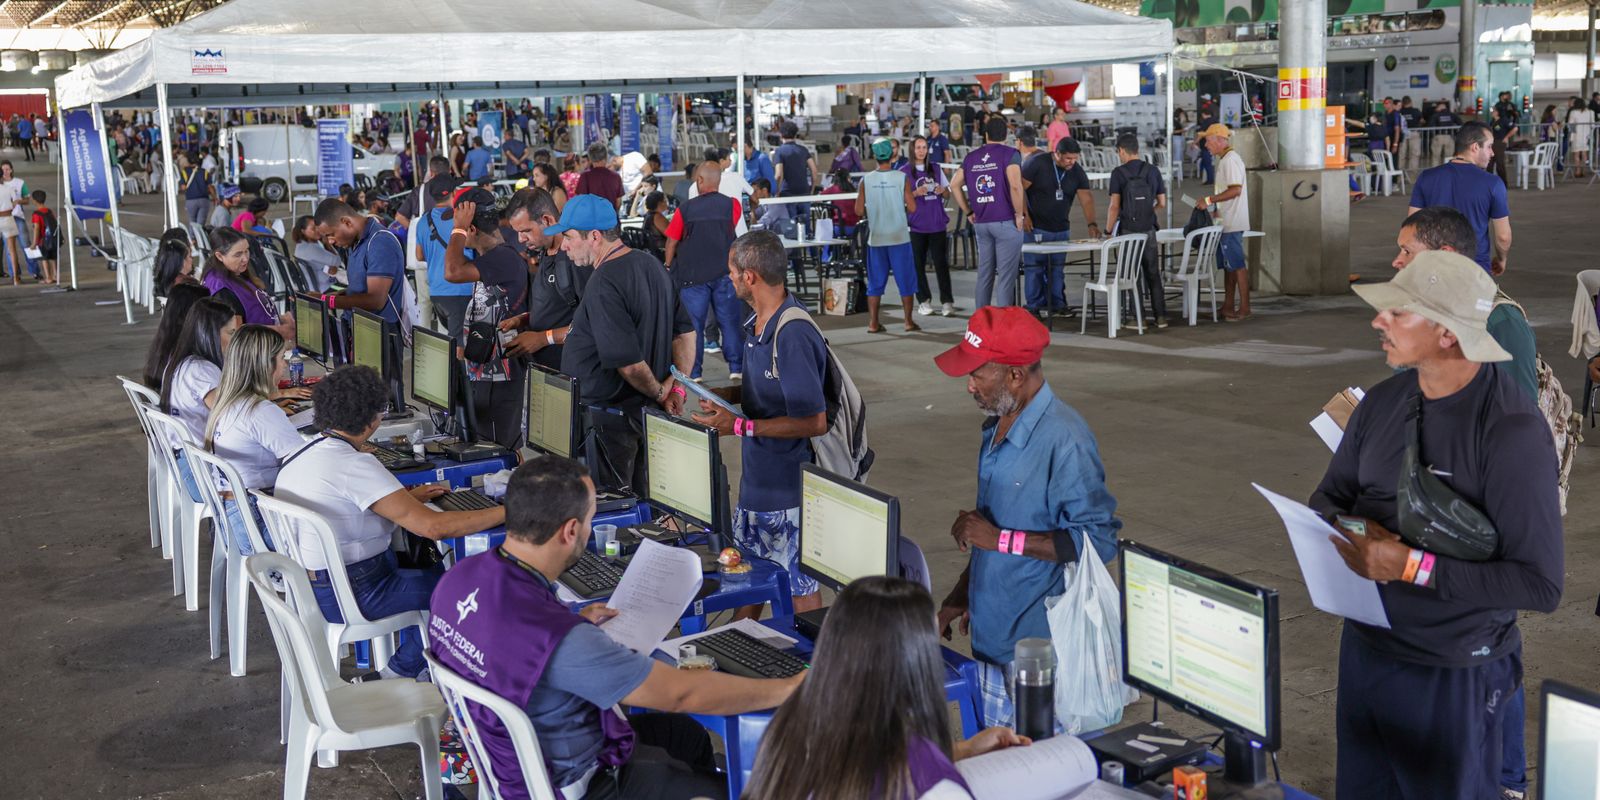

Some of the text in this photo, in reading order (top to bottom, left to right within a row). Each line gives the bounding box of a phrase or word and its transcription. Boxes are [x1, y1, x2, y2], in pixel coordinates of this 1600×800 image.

[69, 128, 87, 193] Trabalhador
[77, 127, 93, 170] Agência
[86, 170, 96, 186] do
[431, 615, 485, 666] JUSTIÇA FEDERAL
